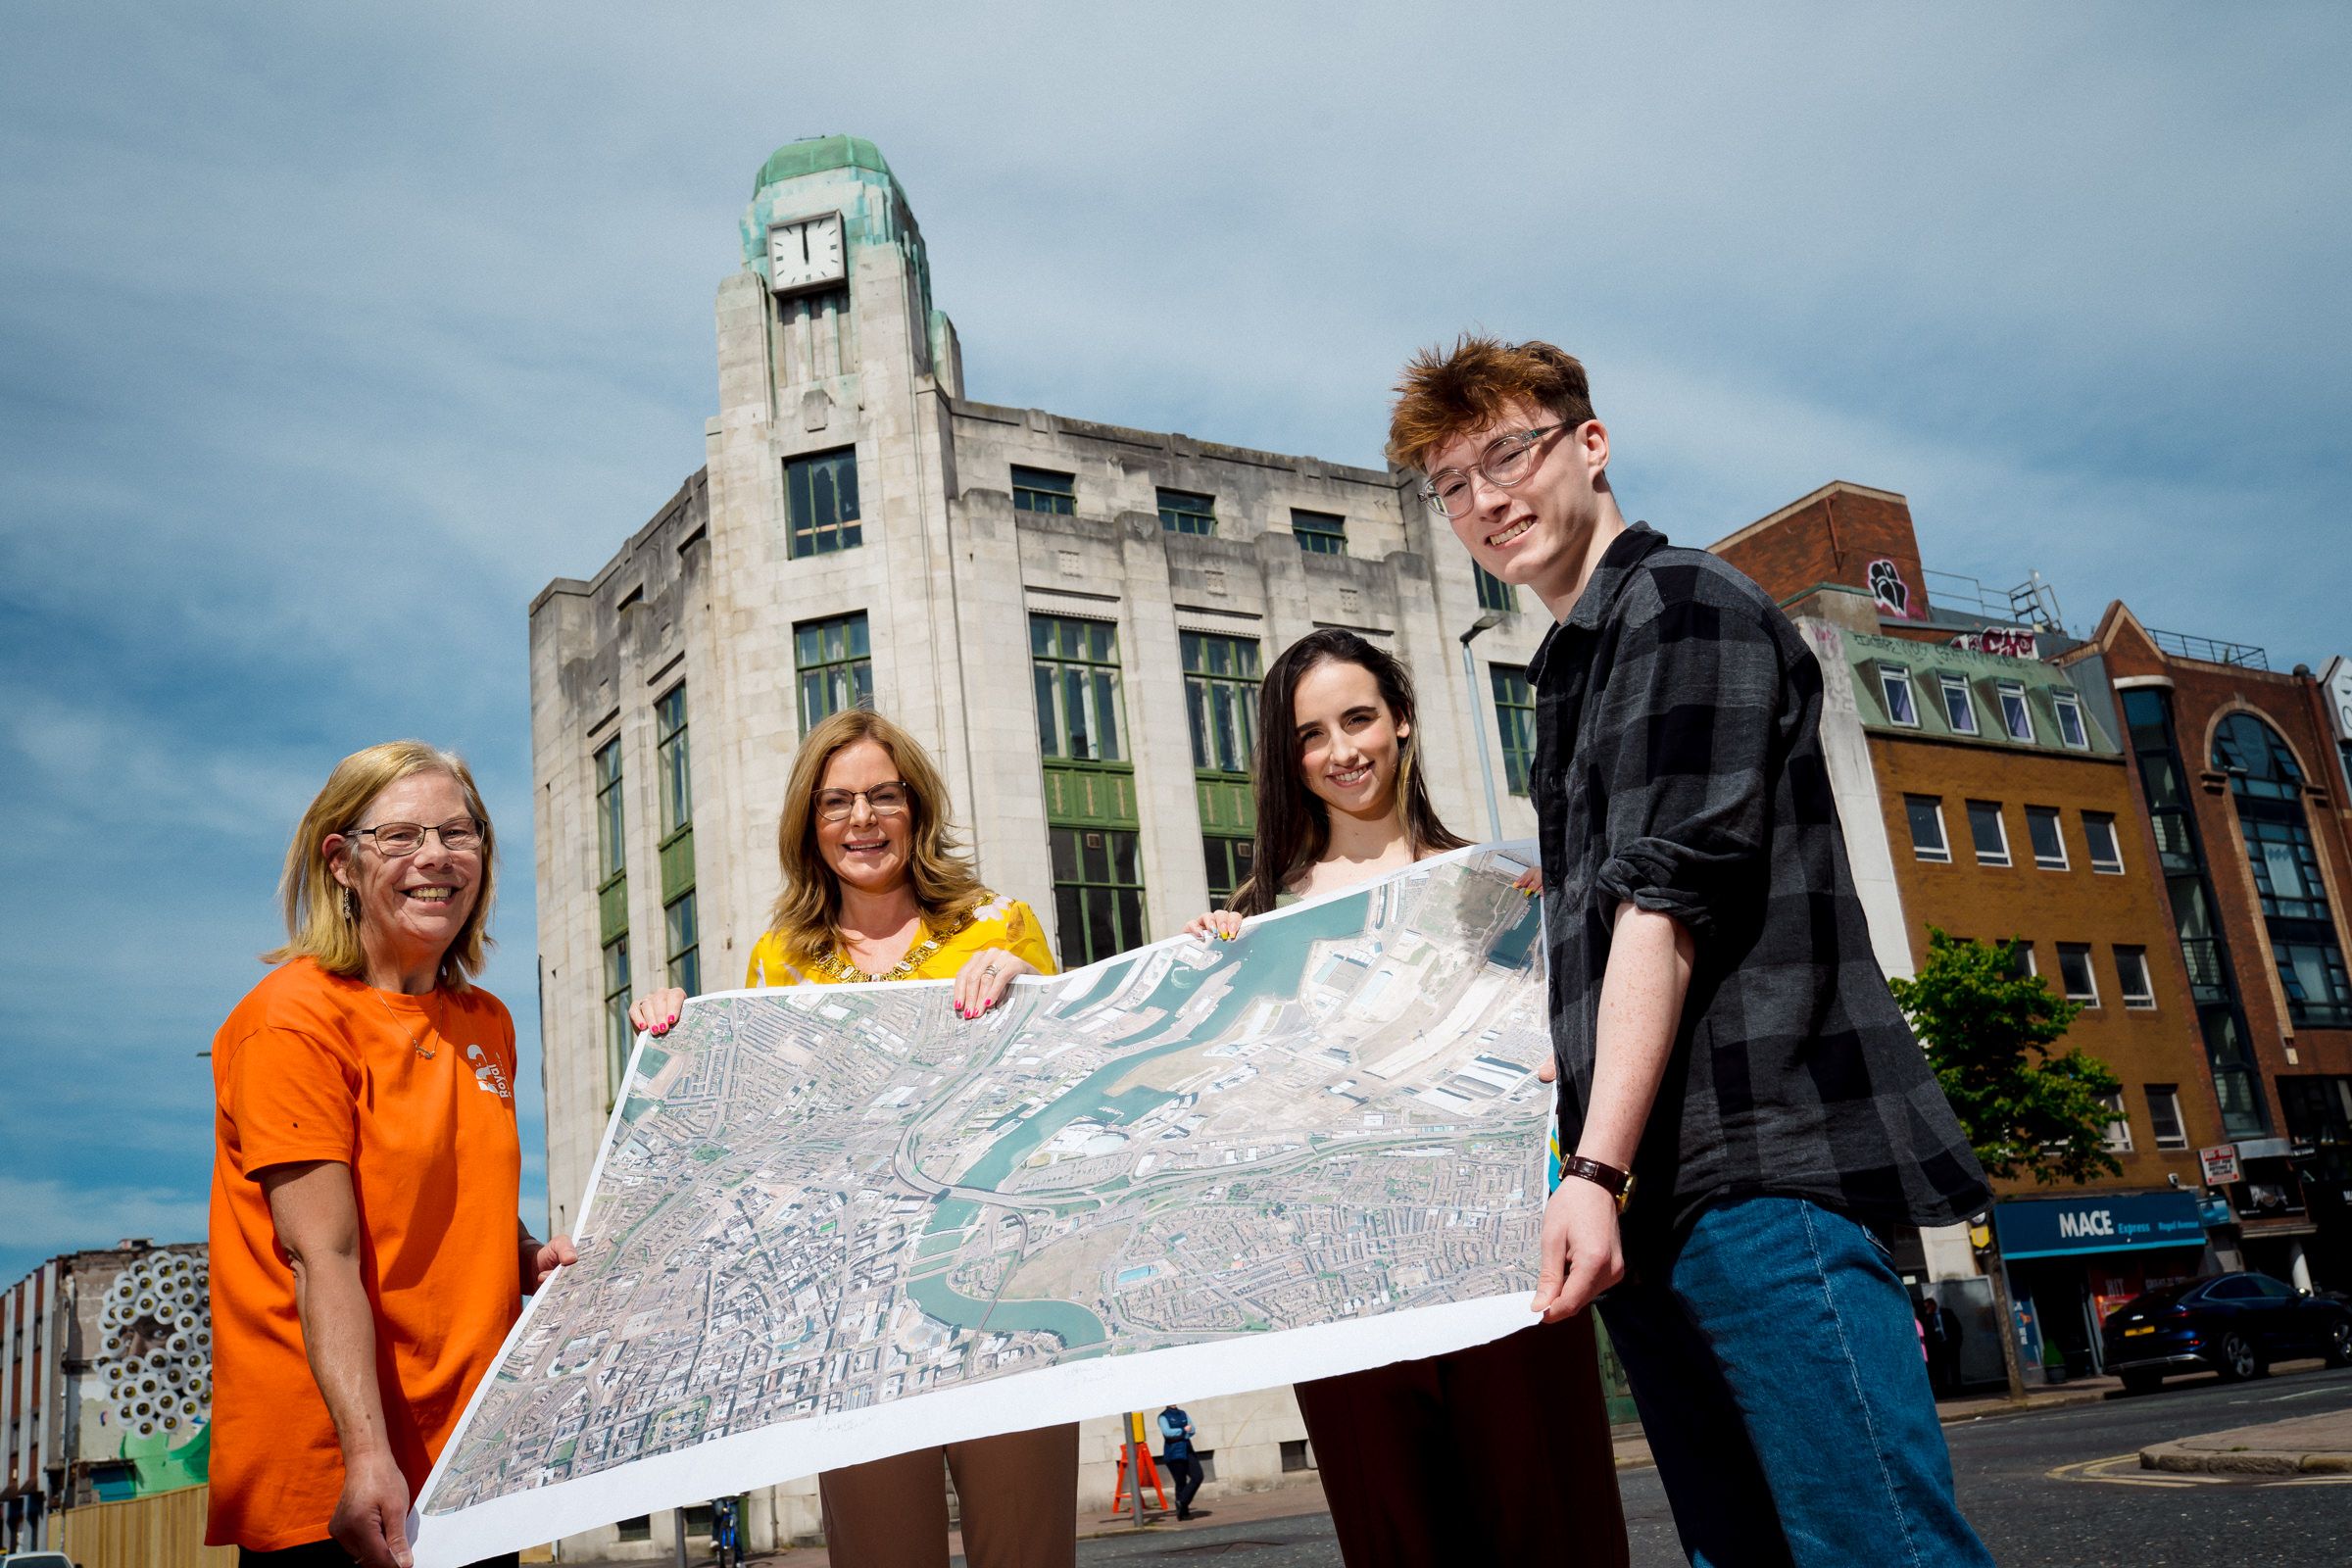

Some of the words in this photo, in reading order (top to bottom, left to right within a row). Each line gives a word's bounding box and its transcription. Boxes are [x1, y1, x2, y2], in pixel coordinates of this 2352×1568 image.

[488, 1063, 509, 1098] Royal
[2059, 1210, 2114, 1238] MACE
[2118, 1222, 2150, 1236] Express
